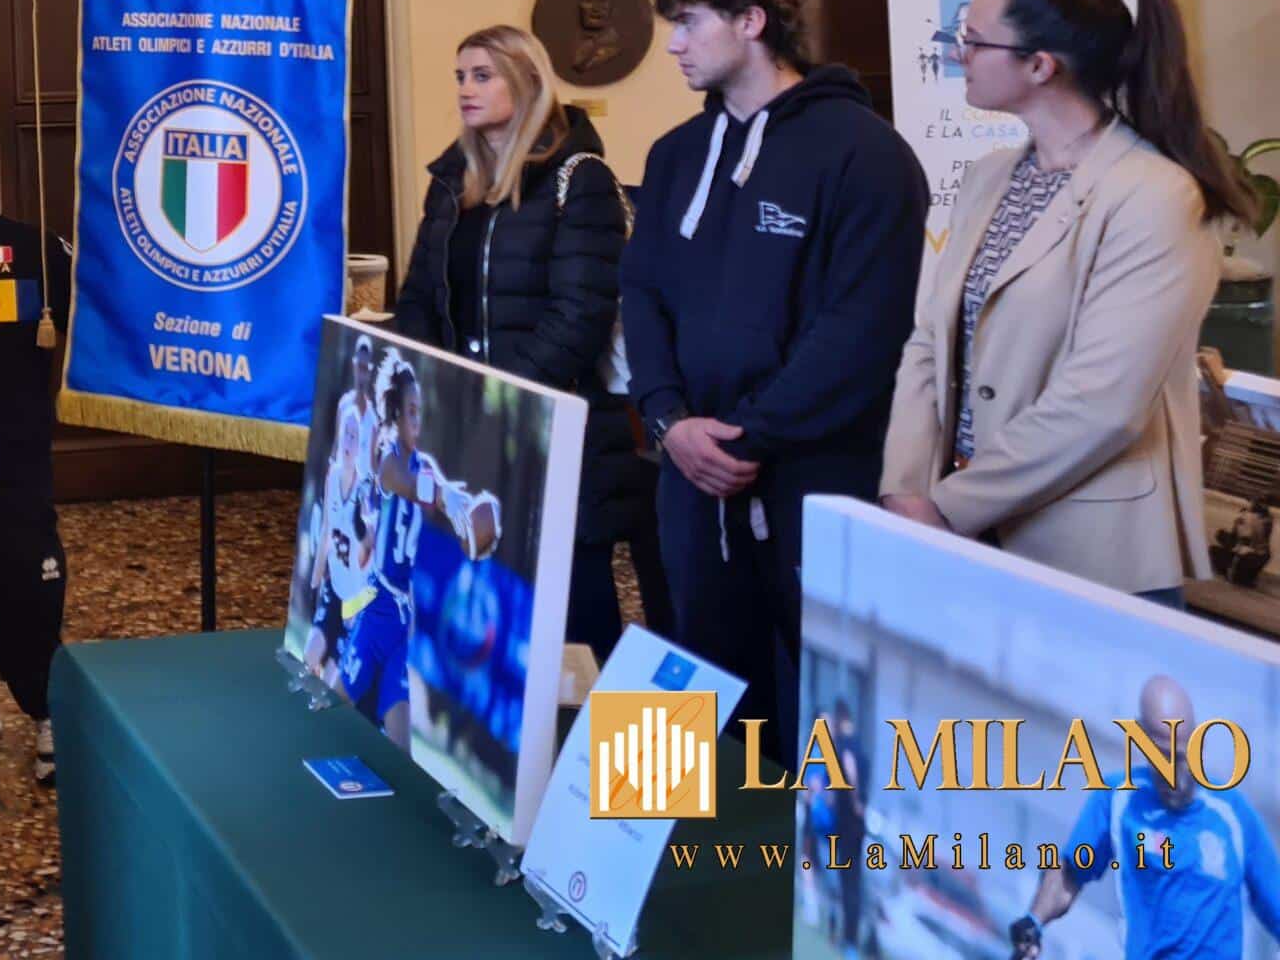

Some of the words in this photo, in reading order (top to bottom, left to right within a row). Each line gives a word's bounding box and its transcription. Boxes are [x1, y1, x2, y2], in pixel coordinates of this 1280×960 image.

[122, 11, 213, 29] ASSOCIAZIONE
[221, 14, 301, 33] NAZIONALE
[92, 35, 132, 52] ATLETI
[138, 37, 192, 54] OLIMPICI
[196, 38, 206, 55] E
[211, 39, 271, 57] AZZURRI
[279, 42, 335, 61] D'ITALIA
[123, 87, 216, 165] ASSOCIAZIONE
[220, 90, 299, 176] NAZIONALE
[167, 131, 244, 159] ITALIA
[120, 187, 140, 236] ATLETI
[137, 235, 190, 279] OLIMPICI
[191, 269, 200, 282] E
[202, 253, 264, 283] AZZURRI
[153, 311, 222, 338] Sezione
[231, 321, 253, 341] di
[148, 343, 253, 383] VERONA
